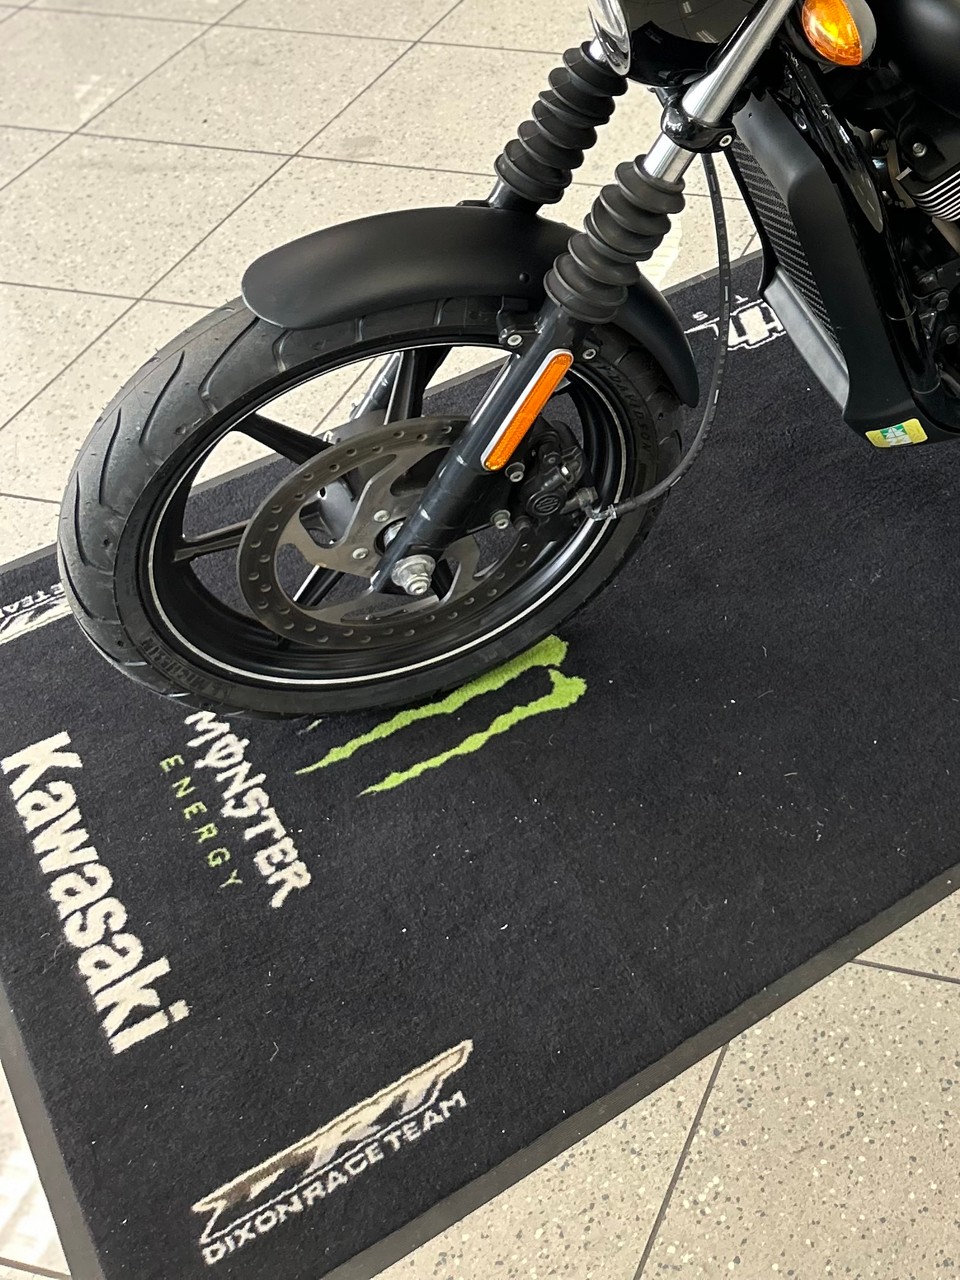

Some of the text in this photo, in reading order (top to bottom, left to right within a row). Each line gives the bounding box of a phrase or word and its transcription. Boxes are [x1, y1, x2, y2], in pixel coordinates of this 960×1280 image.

[159, 754, 243, 889] ENERGY
[1, 730, 192, 1055] Kawasaki
[384, 1090, 468, 1153] TEAM
